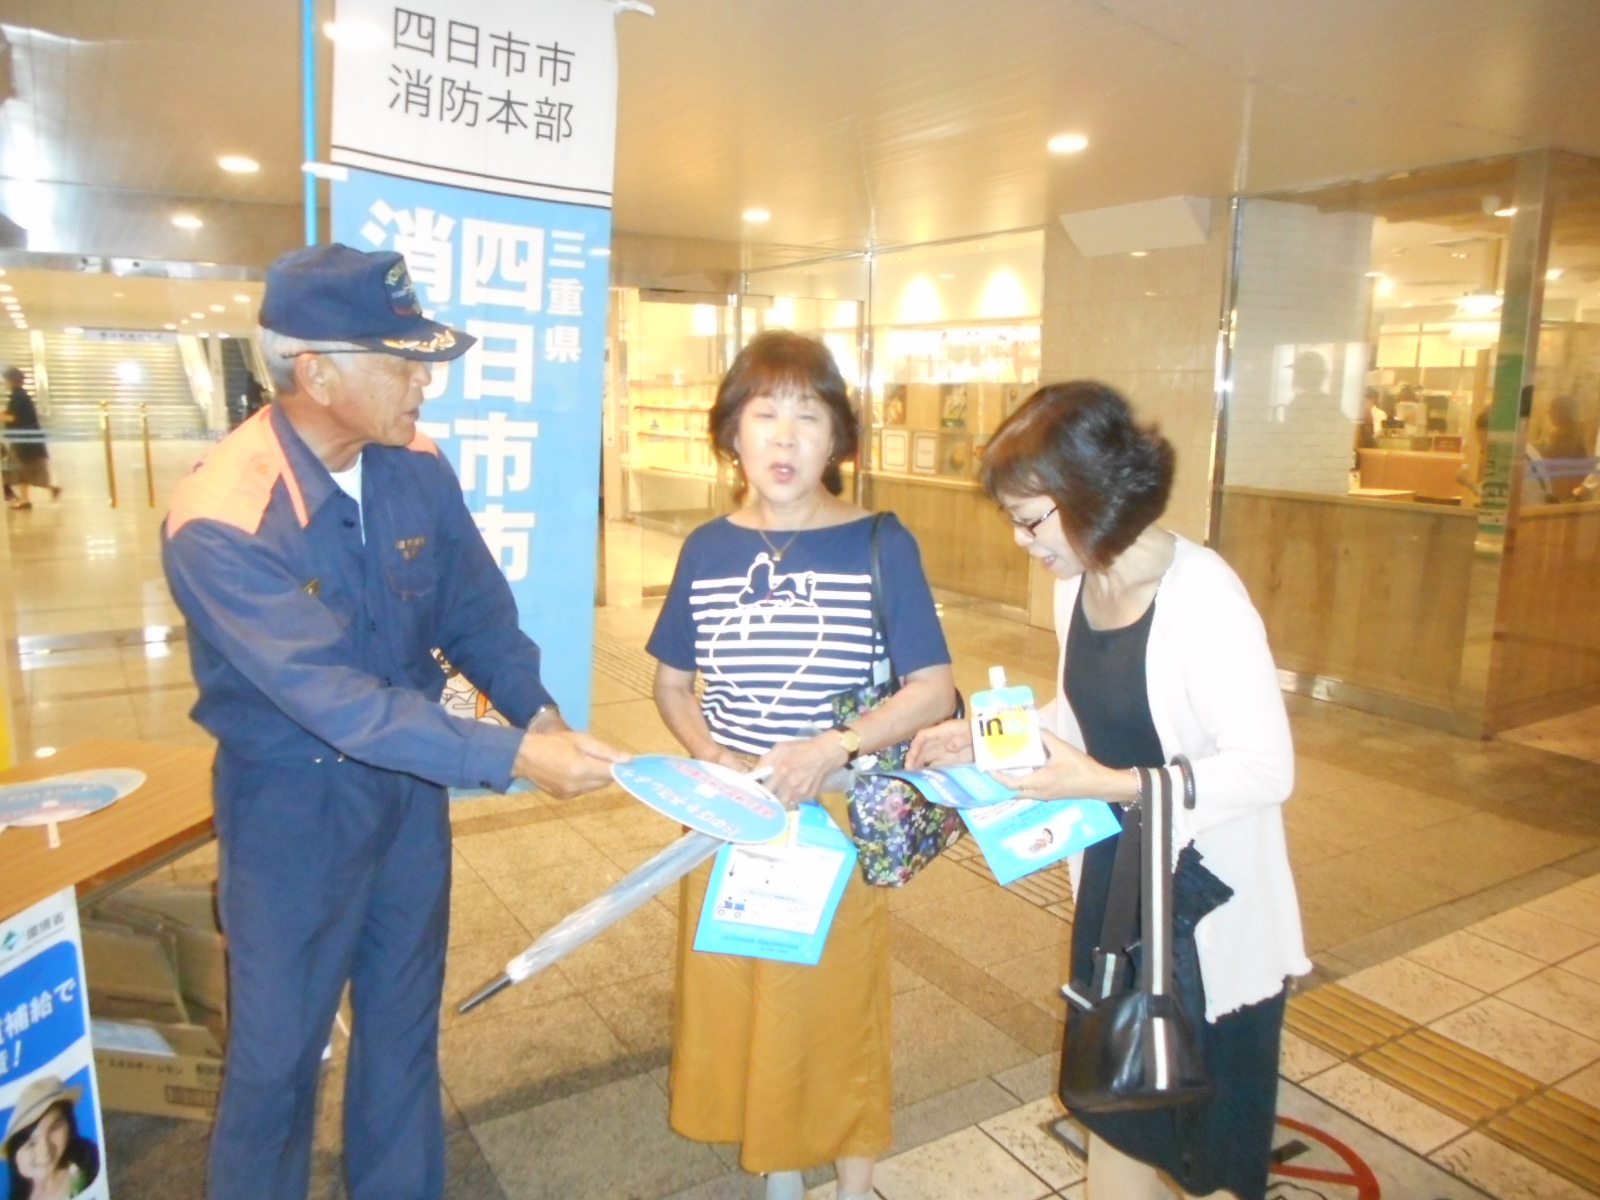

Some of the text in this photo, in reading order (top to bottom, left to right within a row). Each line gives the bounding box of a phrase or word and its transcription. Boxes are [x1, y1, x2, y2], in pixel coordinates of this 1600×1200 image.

[392, 6, 576, 87] 四日市市
[386, 62, 575, 144] 消防本部
[544, 229, 586, 364] 三重県
[454, 217, 546, 582] 四日市市
[977, 711, 1004, 738] in
[0, 976, 77, 1046] 補給で
